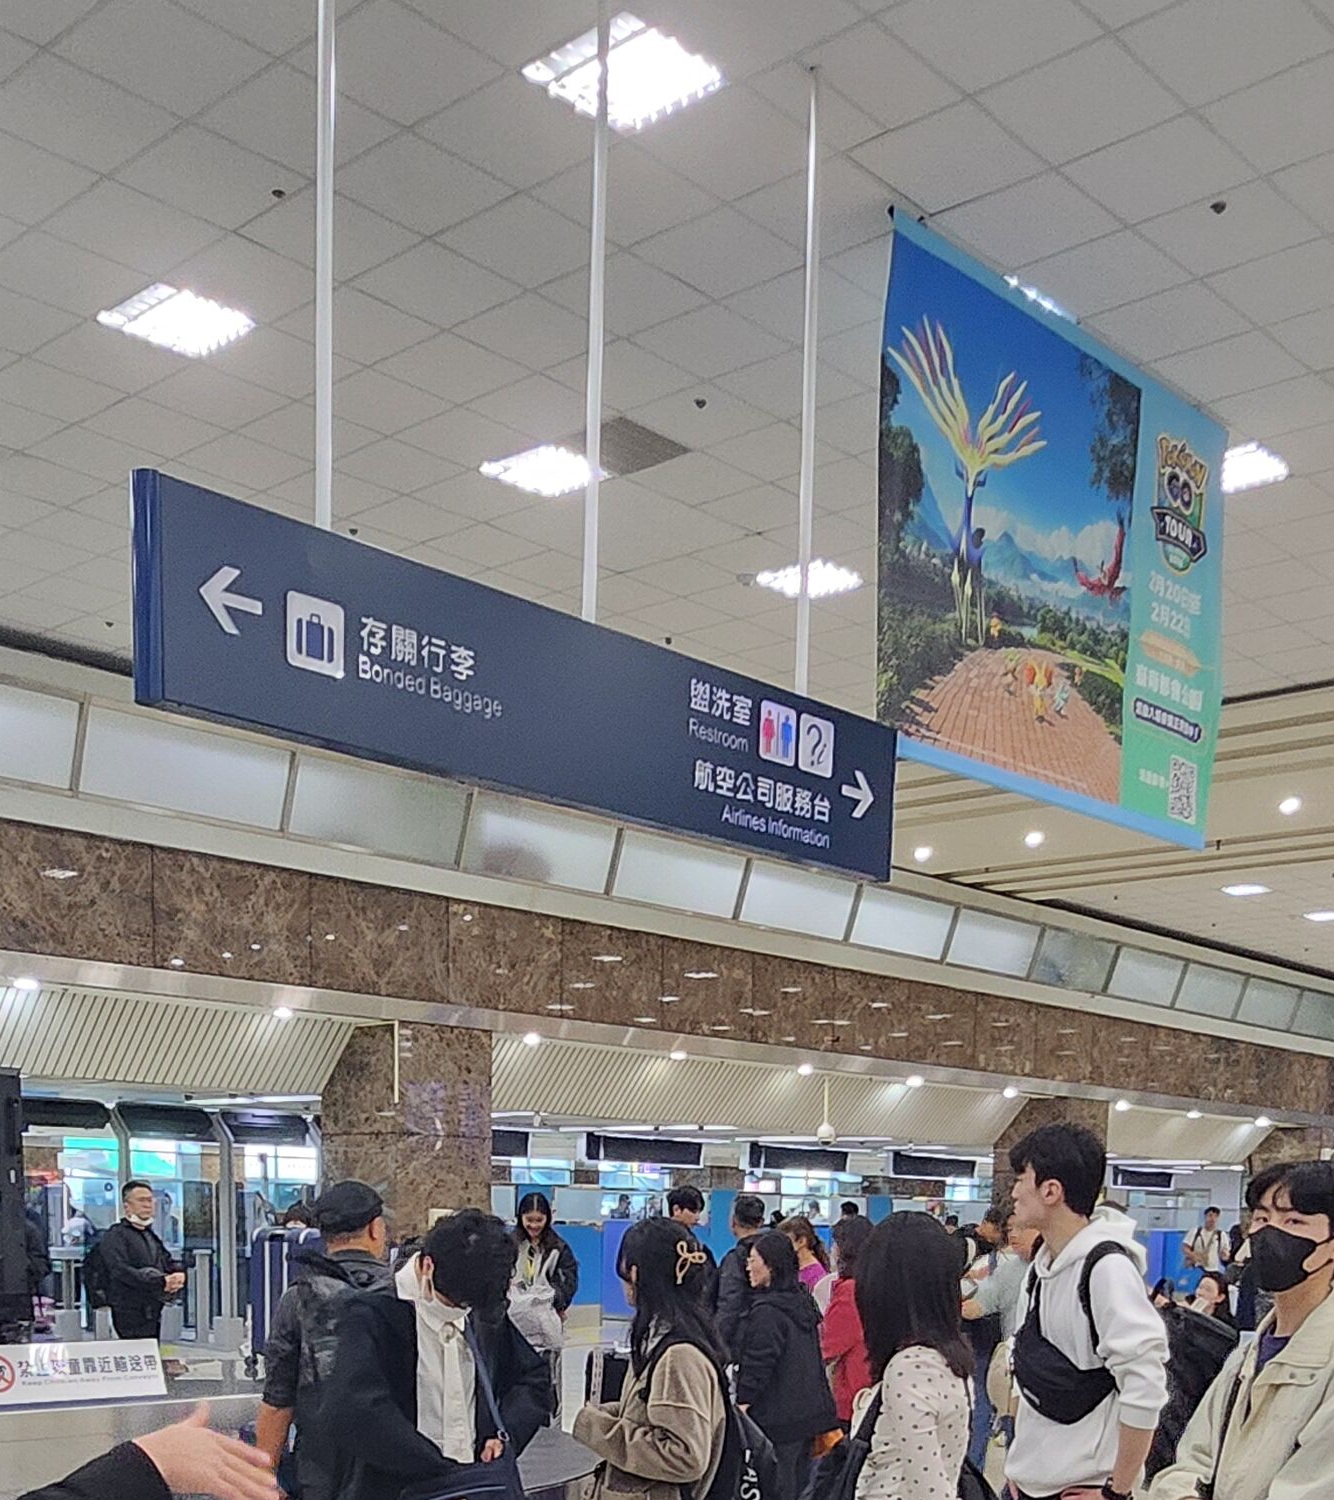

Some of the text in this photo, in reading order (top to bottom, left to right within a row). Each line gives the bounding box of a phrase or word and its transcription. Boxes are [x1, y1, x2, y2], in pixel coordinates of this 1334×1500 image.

[1165, 515, 1193, 548] TOUR
[360, 616, 475, 681] 存關行李
[358, 653, 503, 719] Bonded Baggage
[690, 678, 753, 726] 盥洗室
[689, 717, 749, 752] Restroom
[694, 759, 831, 823] 航空公司服務台
[721, 804, 830, 849] Airlines Information
